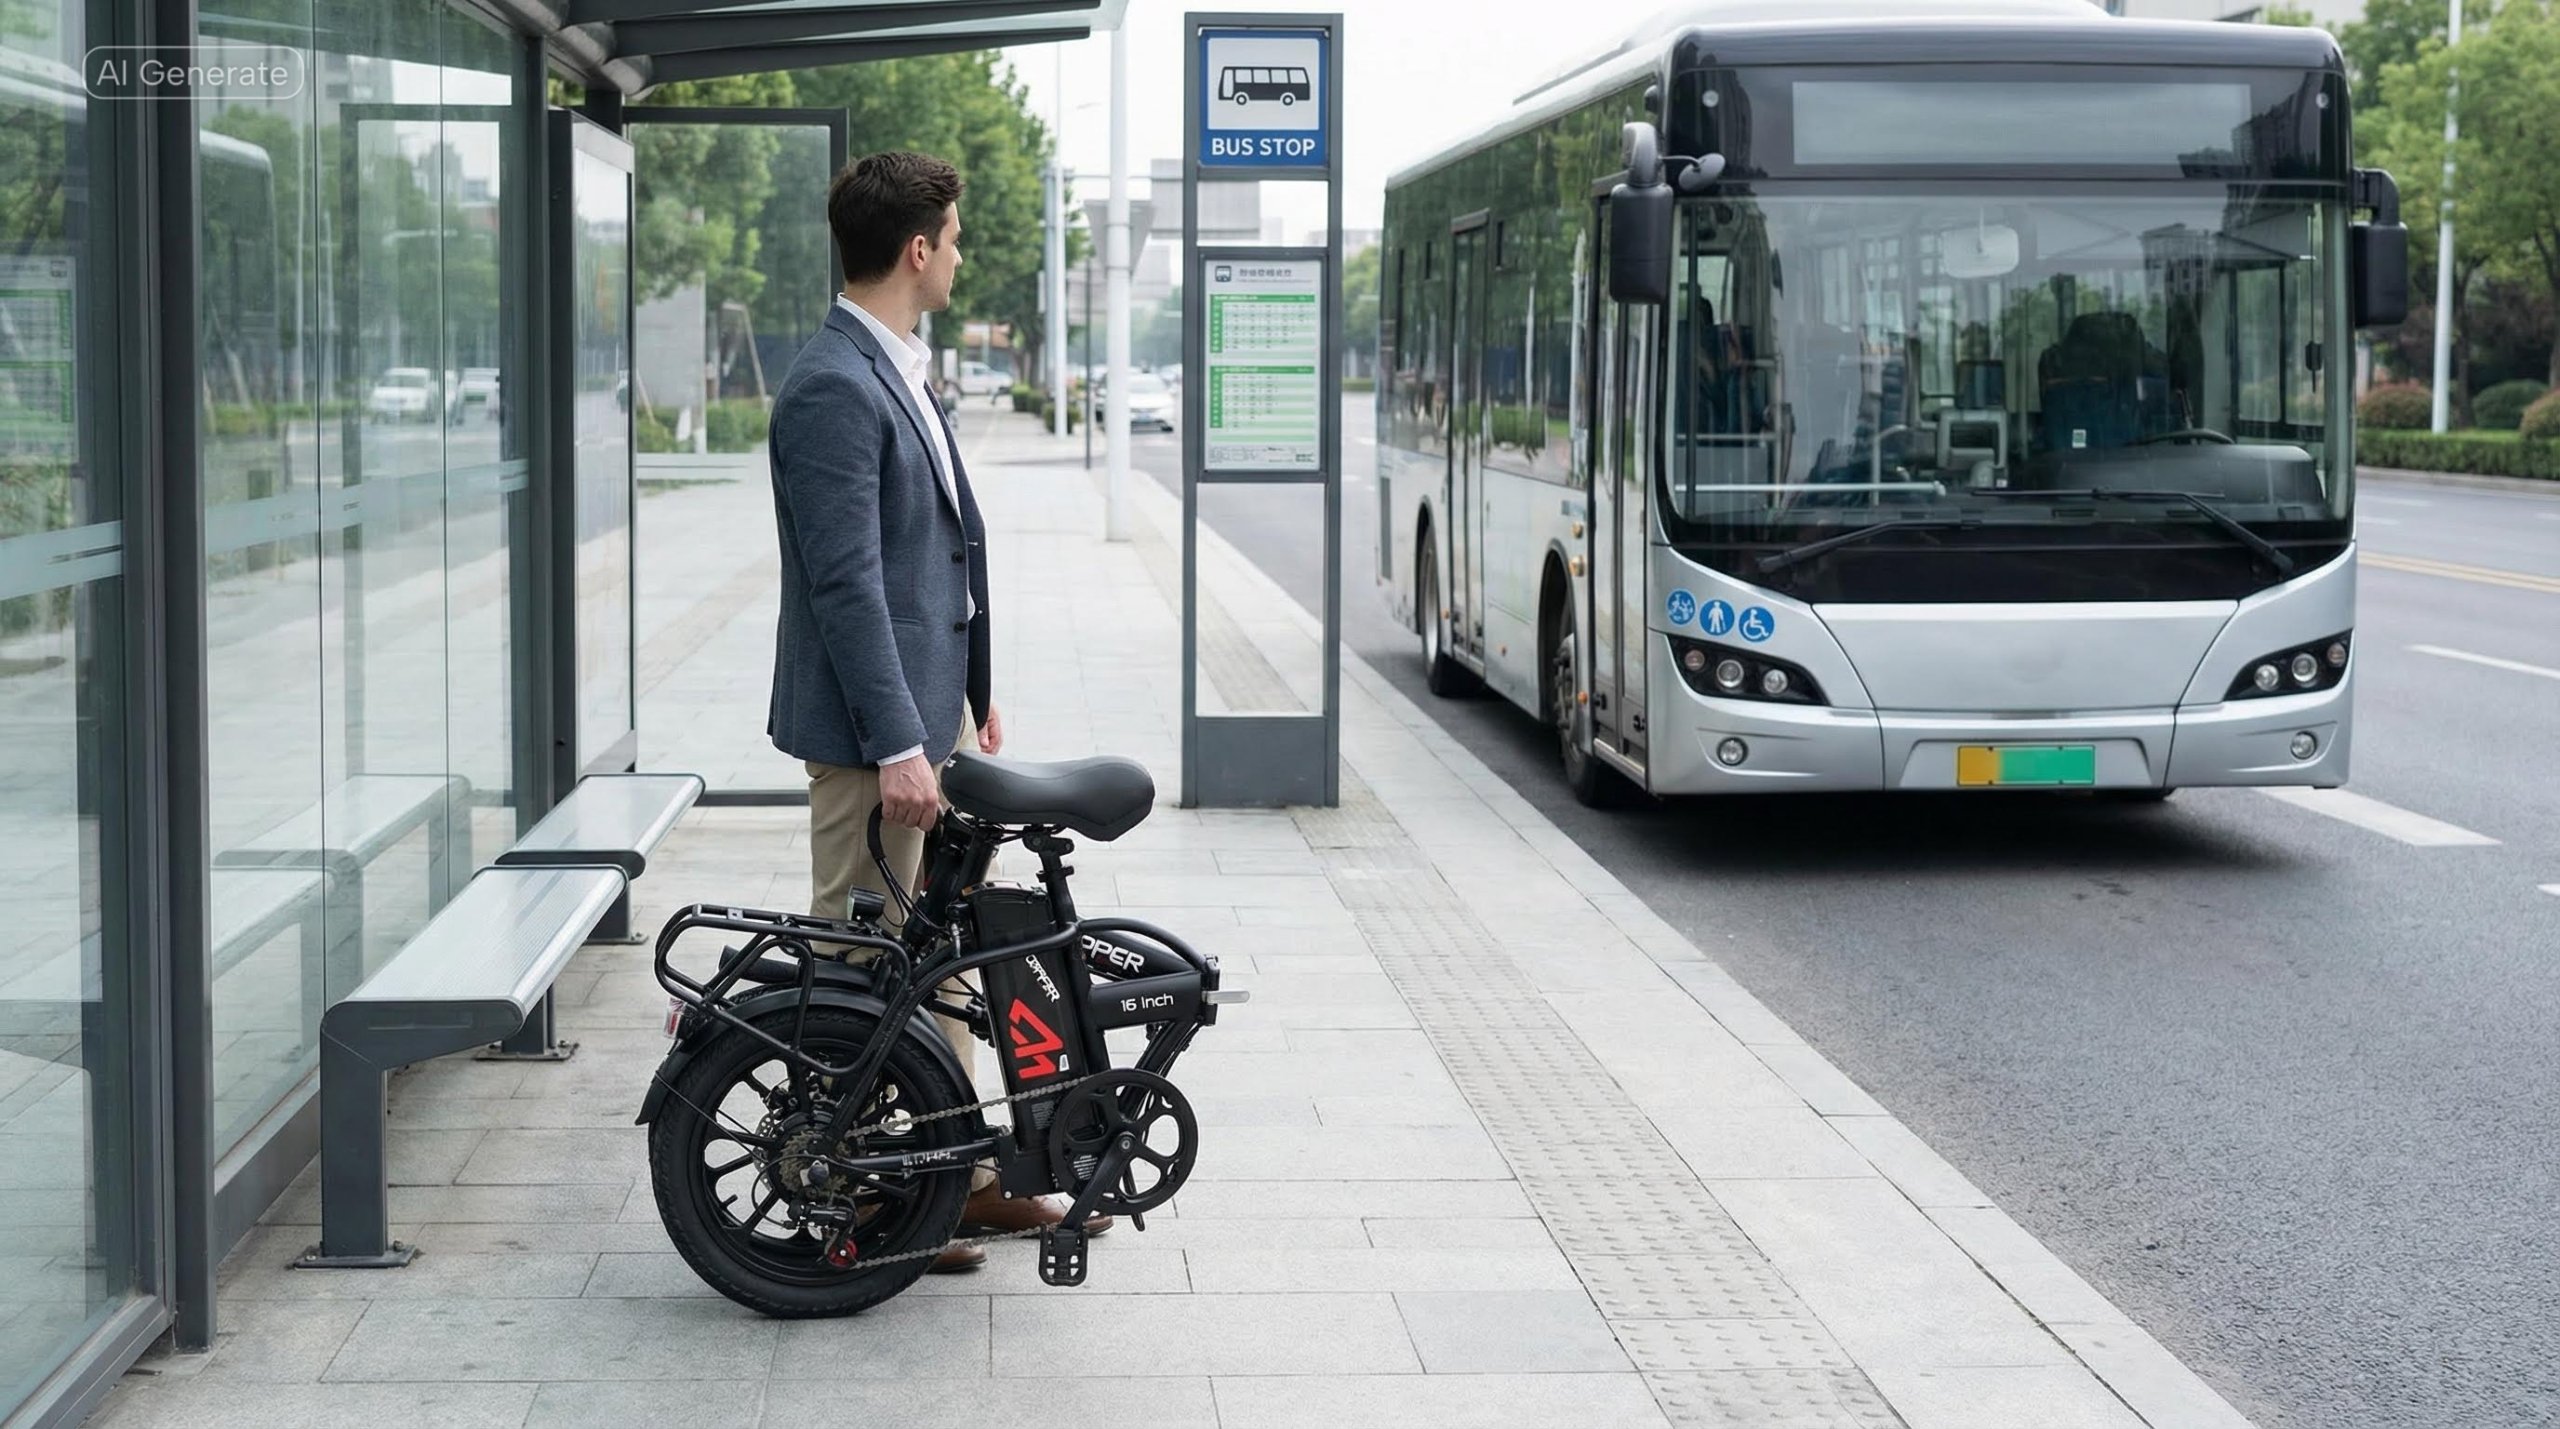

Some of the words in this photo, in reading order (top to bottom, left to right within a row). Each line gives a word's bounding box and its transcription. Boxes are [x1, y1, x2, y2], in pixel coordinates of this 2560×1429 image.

[1211, 138, 1254, 156] BUS
[1259, 138, 1316, 156] STOP
[1120, 998, 1137, 1012] 16
